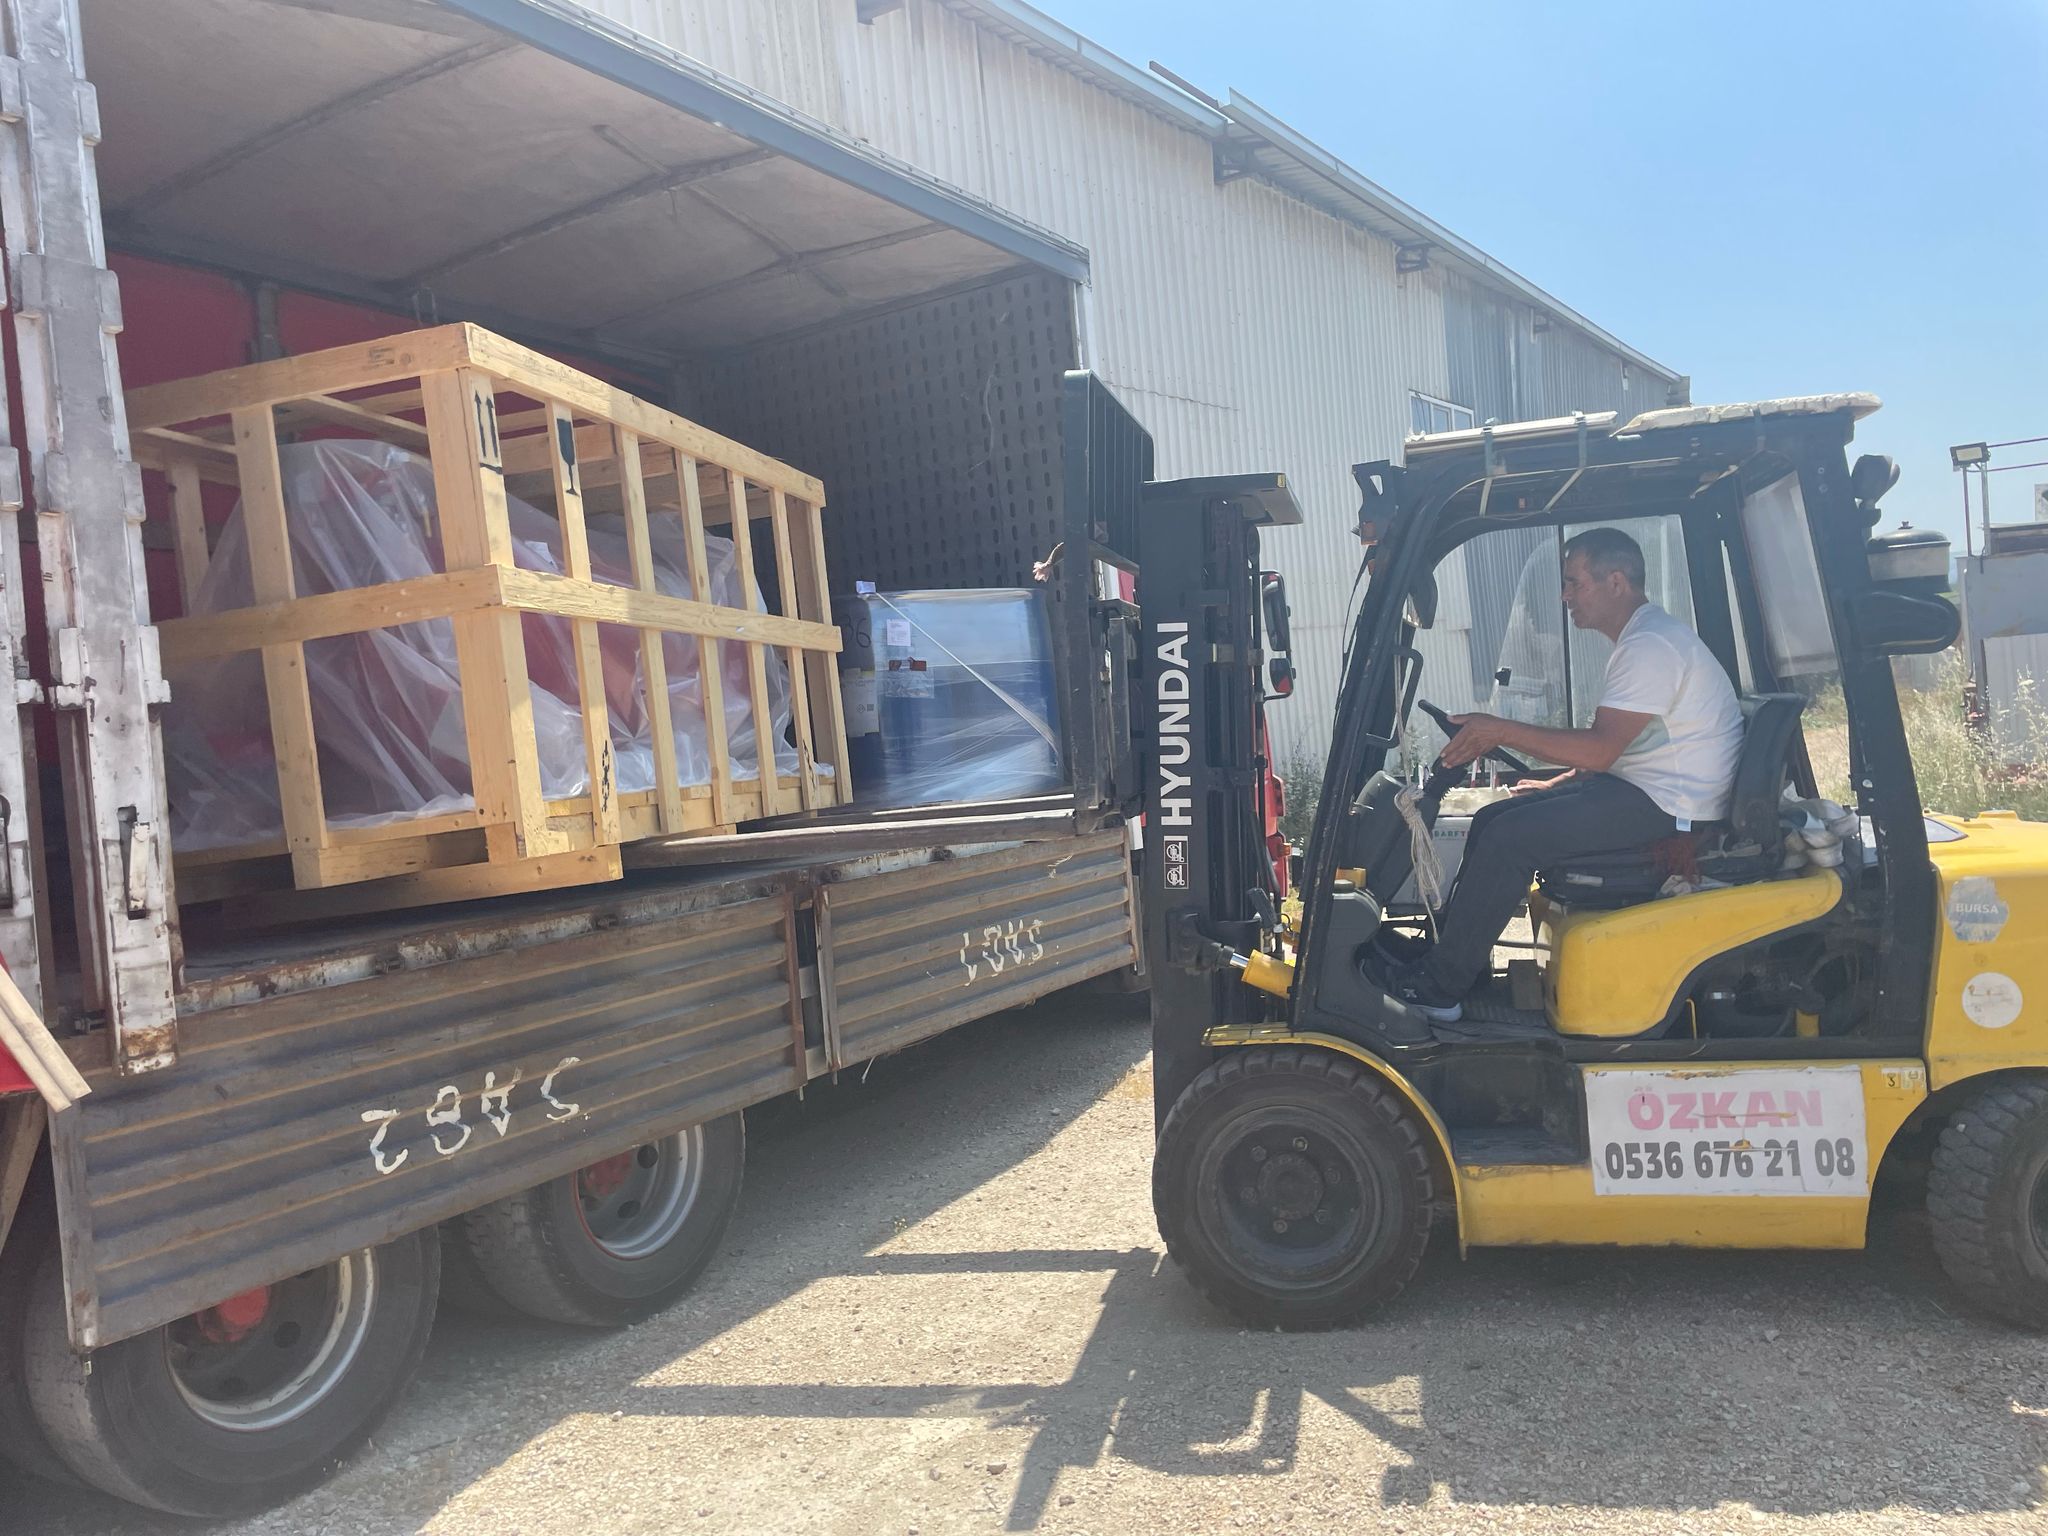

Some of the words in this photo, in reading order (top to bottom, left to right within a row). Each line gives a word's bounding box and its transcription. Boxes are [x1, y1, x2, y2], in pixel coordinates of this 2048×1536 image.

[1156, 621, 1192, 827] HYUNDAI
[1955, 903, 1999, 915] BURSA
[1626, 1085, 1824, 1131] ÖZKAN
[1605, 1141, 1684, 1180] 0536
[1693, 1139, 1754, 1179] 676
[1764, 1139, 1802, 1177] 21
[1814, 1138, 1856, 1177] 08
